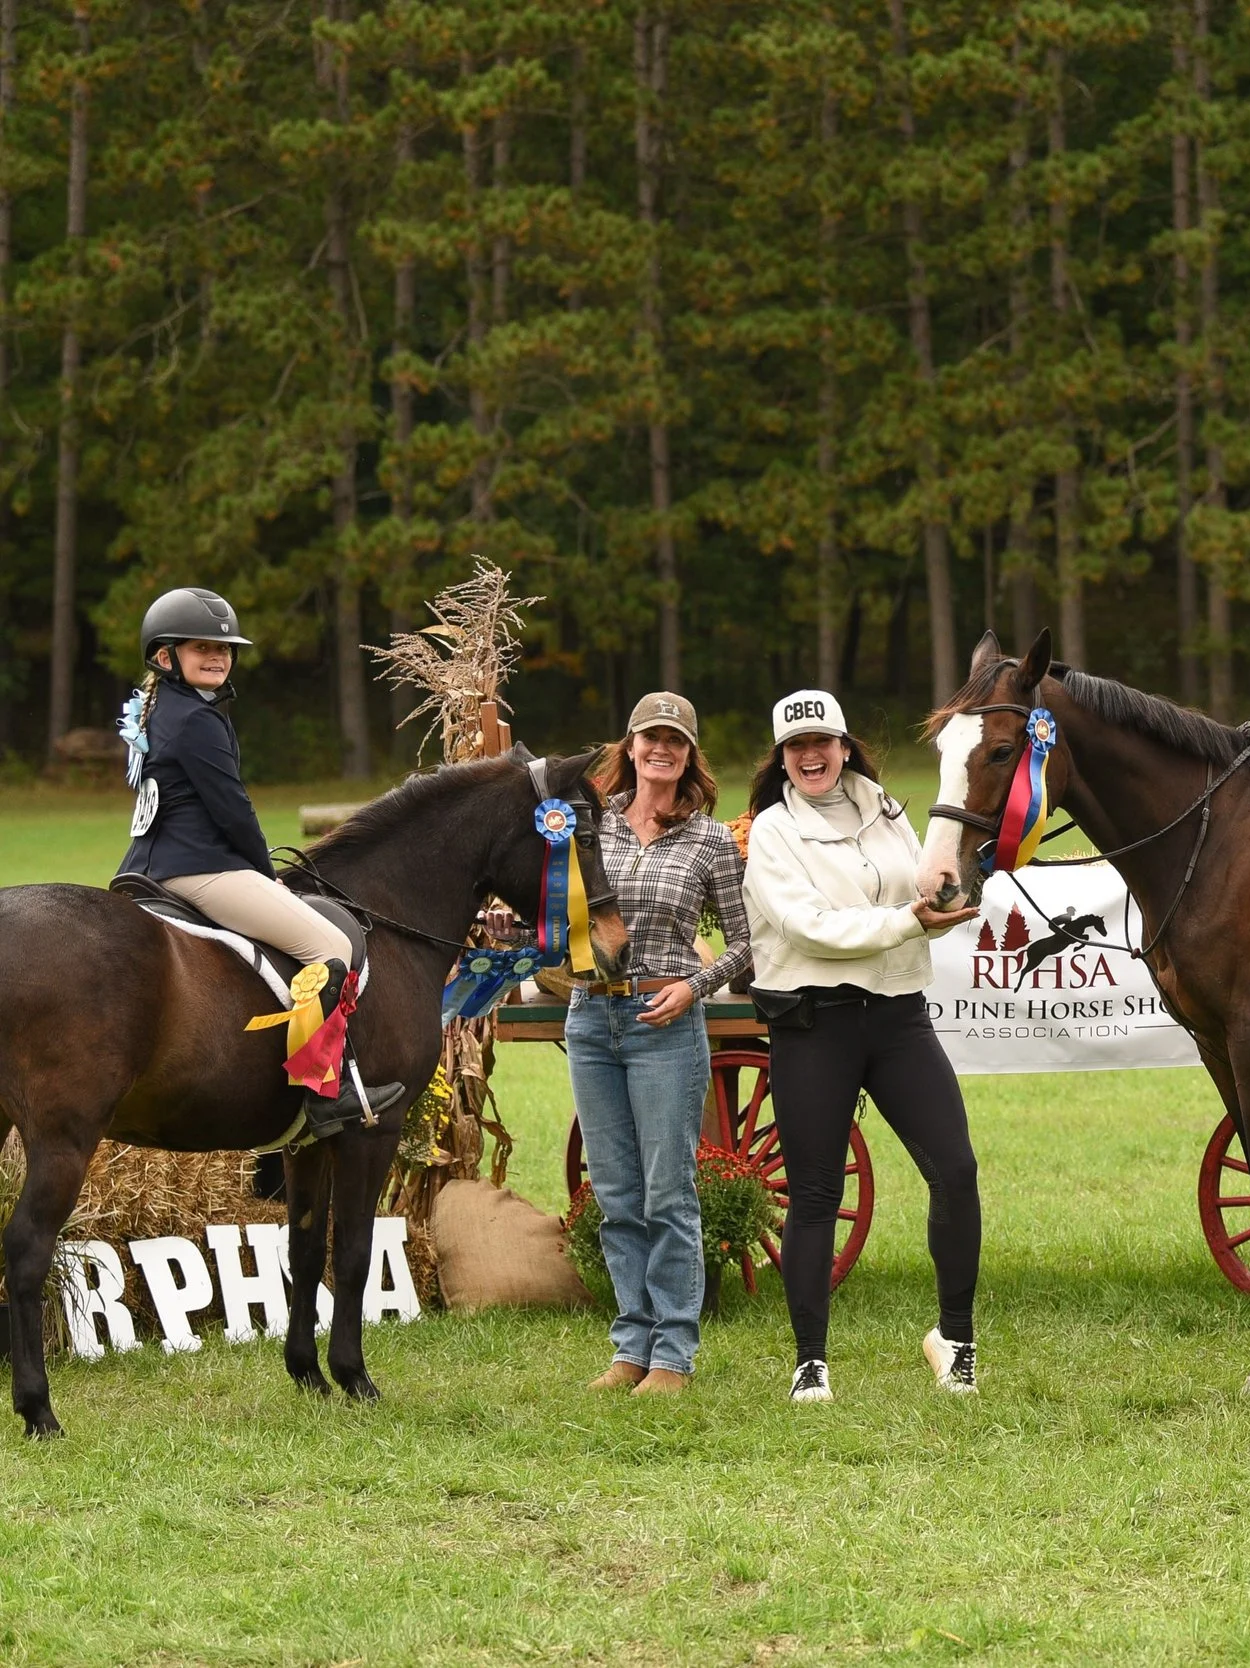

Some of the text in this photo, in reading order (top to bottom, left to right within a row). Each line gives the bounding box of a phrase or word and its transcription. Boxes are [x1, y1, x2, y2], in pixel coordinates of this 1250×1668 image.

[784, 700, 825, 723] CBEQ
[970, 952, 1120, 989] RPHSA
[954, 1000, 1015, 1020] PINE
[1026, 1000, 1113, 1020] HORSE
[965, 1025, 1128, 1039] ASSOCIATION
